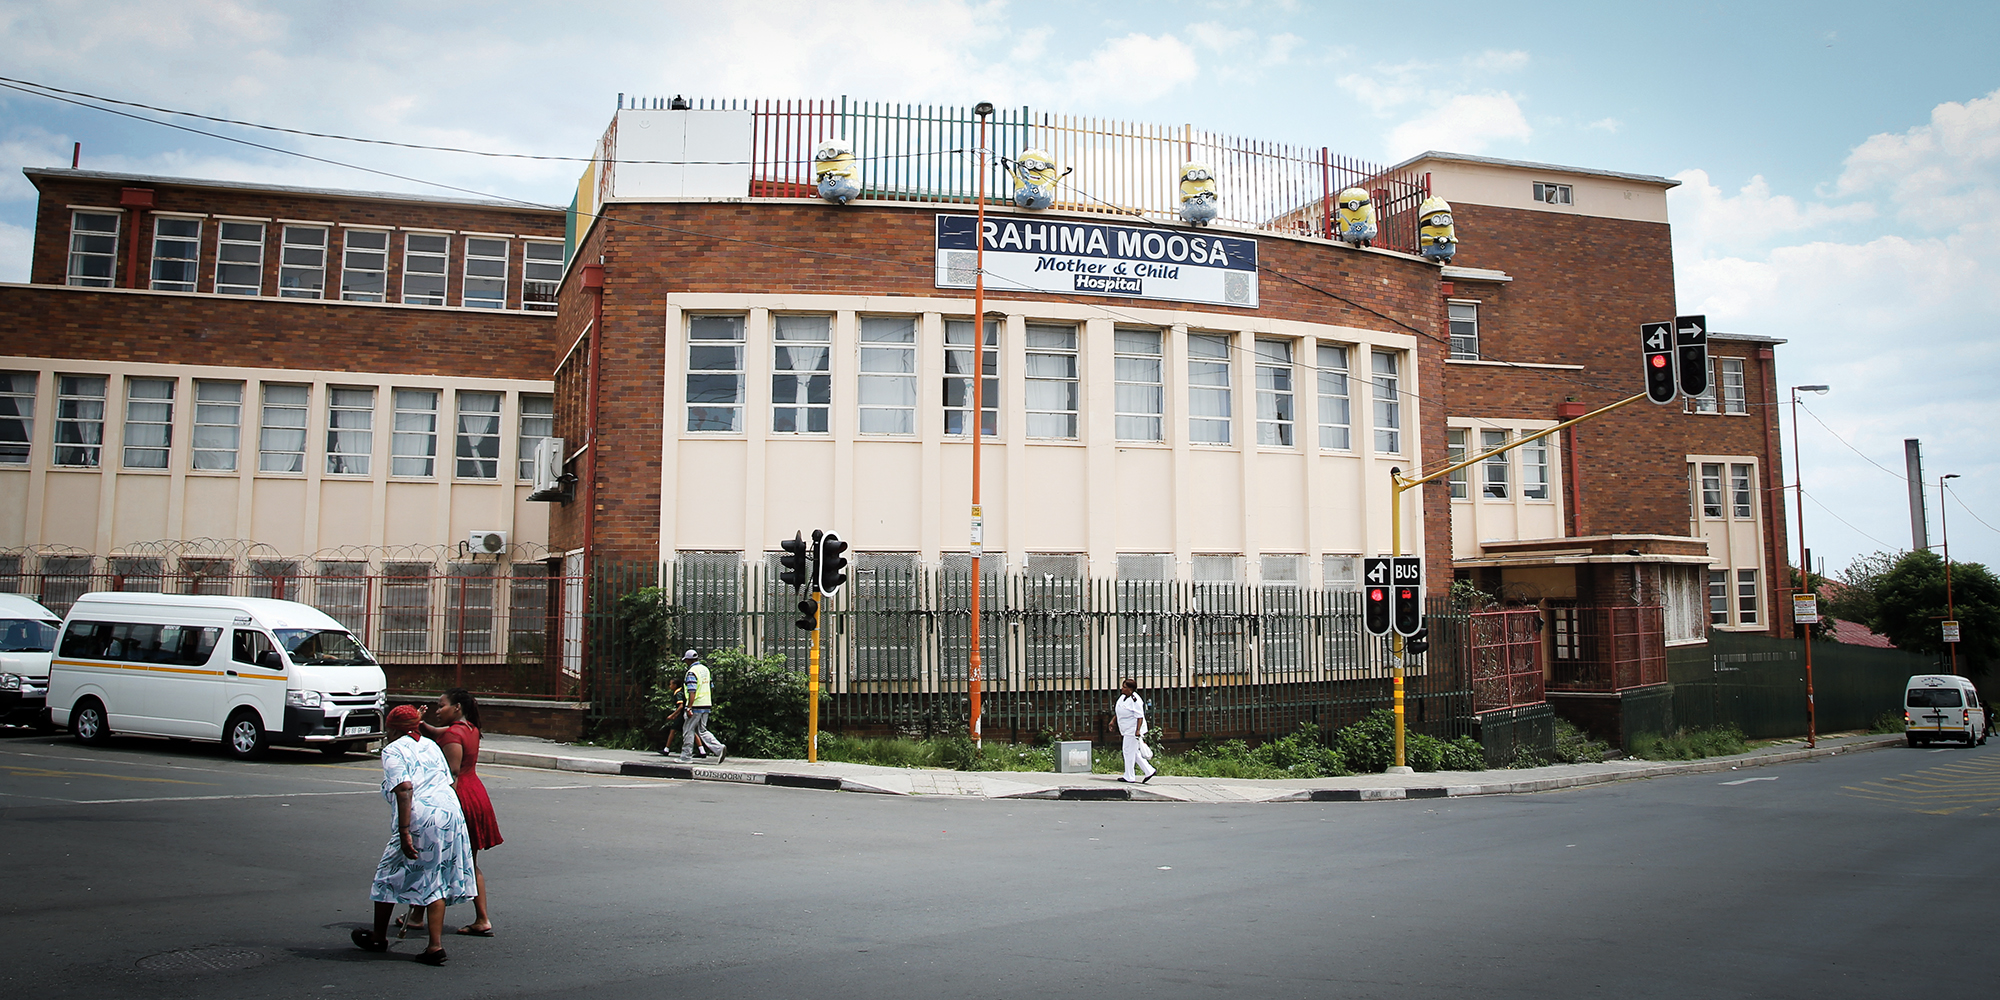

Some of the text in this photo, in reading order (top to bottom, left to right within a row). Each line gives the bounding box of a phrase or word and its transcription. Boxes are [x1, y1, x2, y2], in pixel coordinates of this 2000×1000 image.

[975, 221, 1229, 267] RAHIMA MOOSA
[1034, 256, 1179, 280] Mother & Child
[1076, 275, 1141, 292] Hospital
[1395, 564, 1418, 579] BUS
